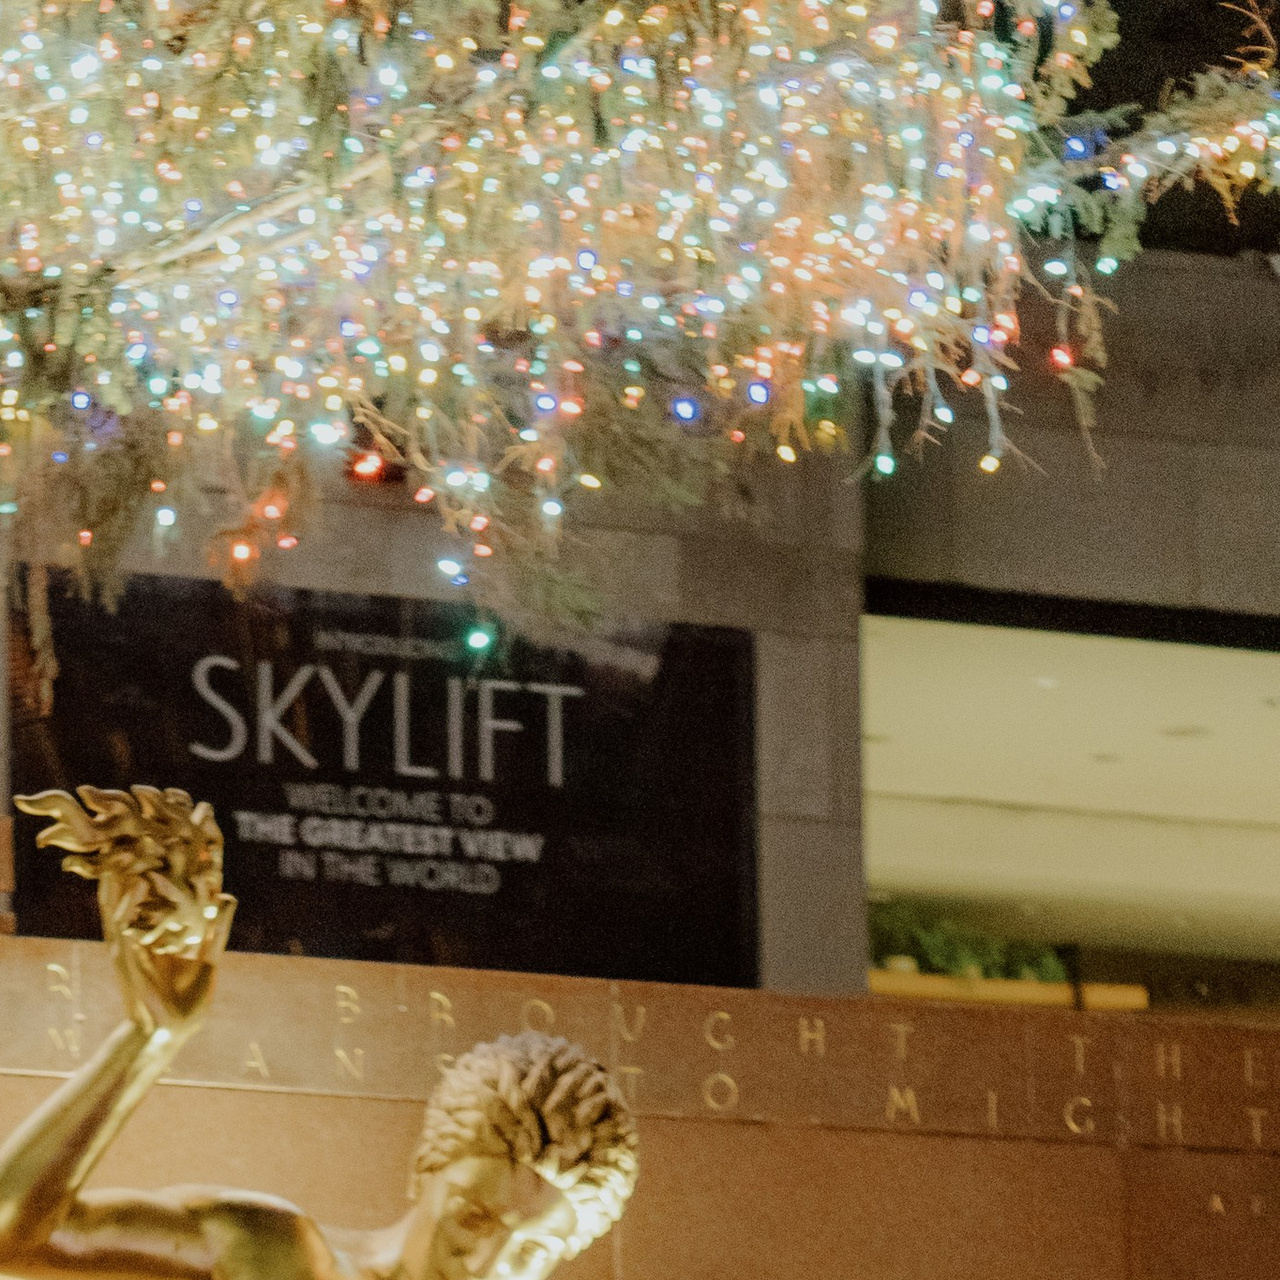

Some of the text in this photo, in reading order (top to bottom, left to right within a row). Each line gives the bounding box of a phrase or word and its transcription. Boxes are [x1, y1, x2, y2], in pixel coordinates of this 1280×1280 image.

[188, 655, 587, 788] SKYLIFT
[283, 782, 495, 826] WELCOME TO
[232, 810, 545, 863] THE GREATEST VIEW
[278, 850, 503, 894] IN THE WORLD
[616, 1065, 740, 1111] TO
